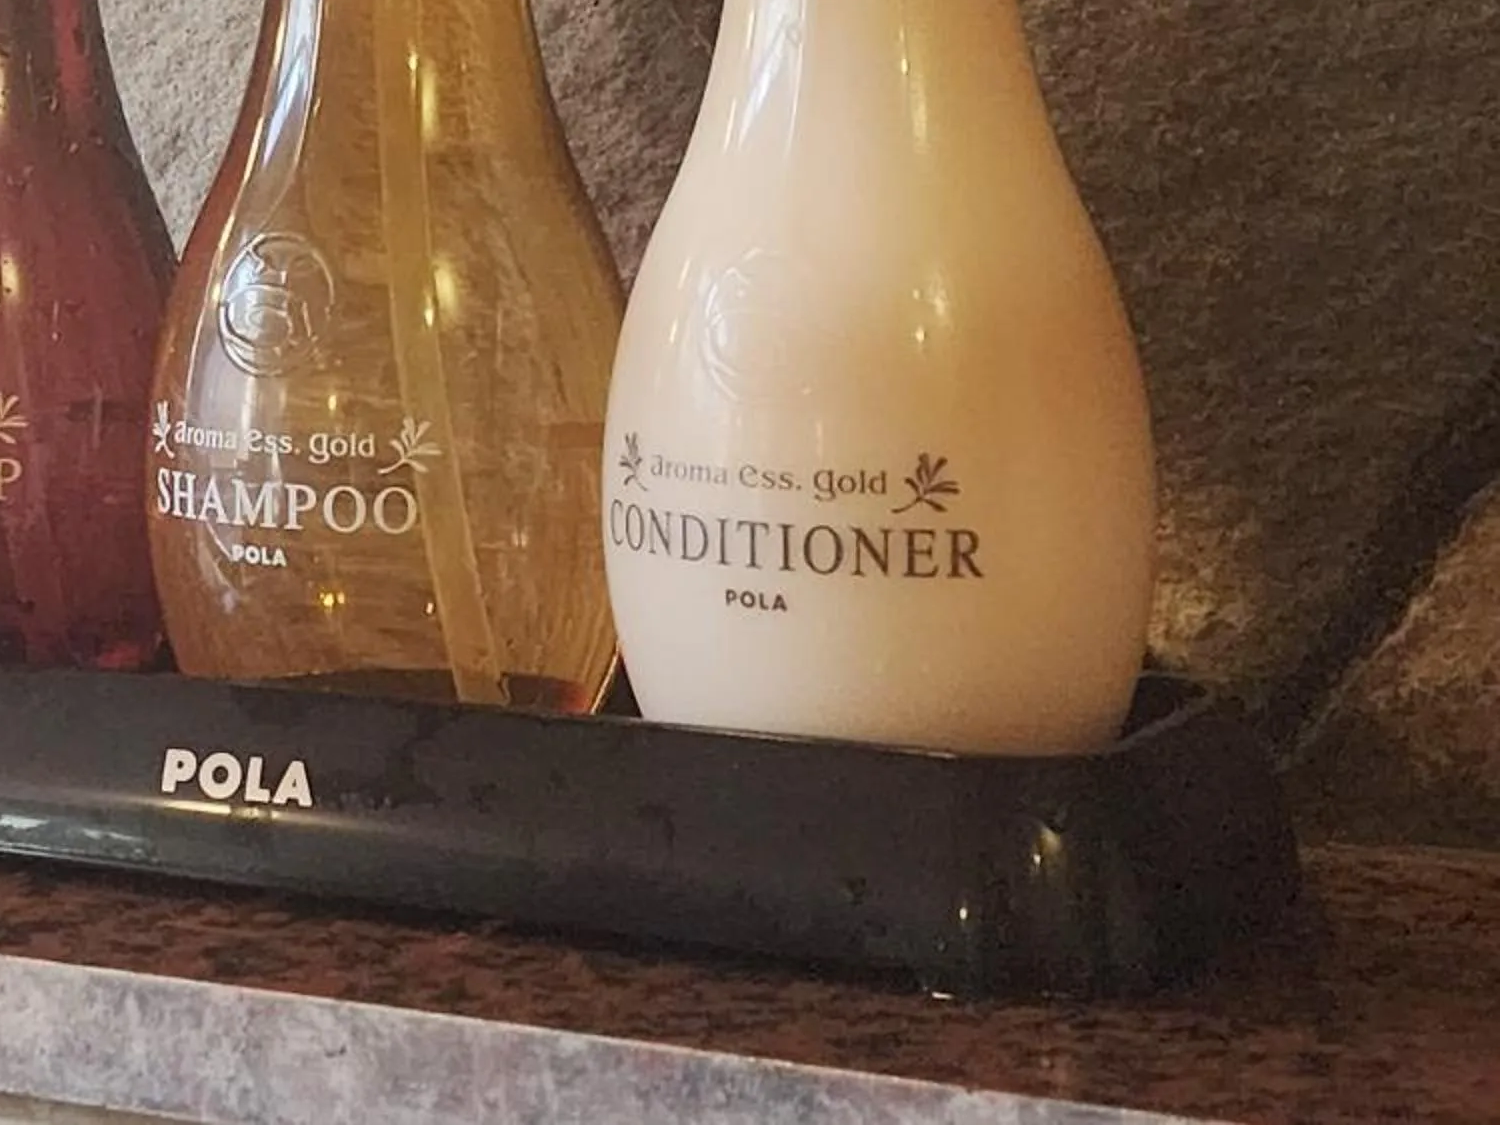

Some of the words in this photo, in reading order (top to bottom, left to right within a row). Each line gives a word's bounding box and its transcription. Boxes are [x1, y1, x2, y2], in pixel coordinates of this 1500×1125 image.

[173, 421, 237, 451] aroma
[248, 429, 300, 455] ess.
[308, 432, 376, 464] gold
[156, 467, 418, 535] SHAMPOO
[650, 454, 728, 486] aroma
[738, 464, 802, 492] ess.
[812, 469, 888, 502] gold
[231, 543, 287, 568] POLA
[609, 498, 985, 579] CONDITIONER
[725, 588, 789, 613] POLA
[160, 747, 313, 808] POLA
